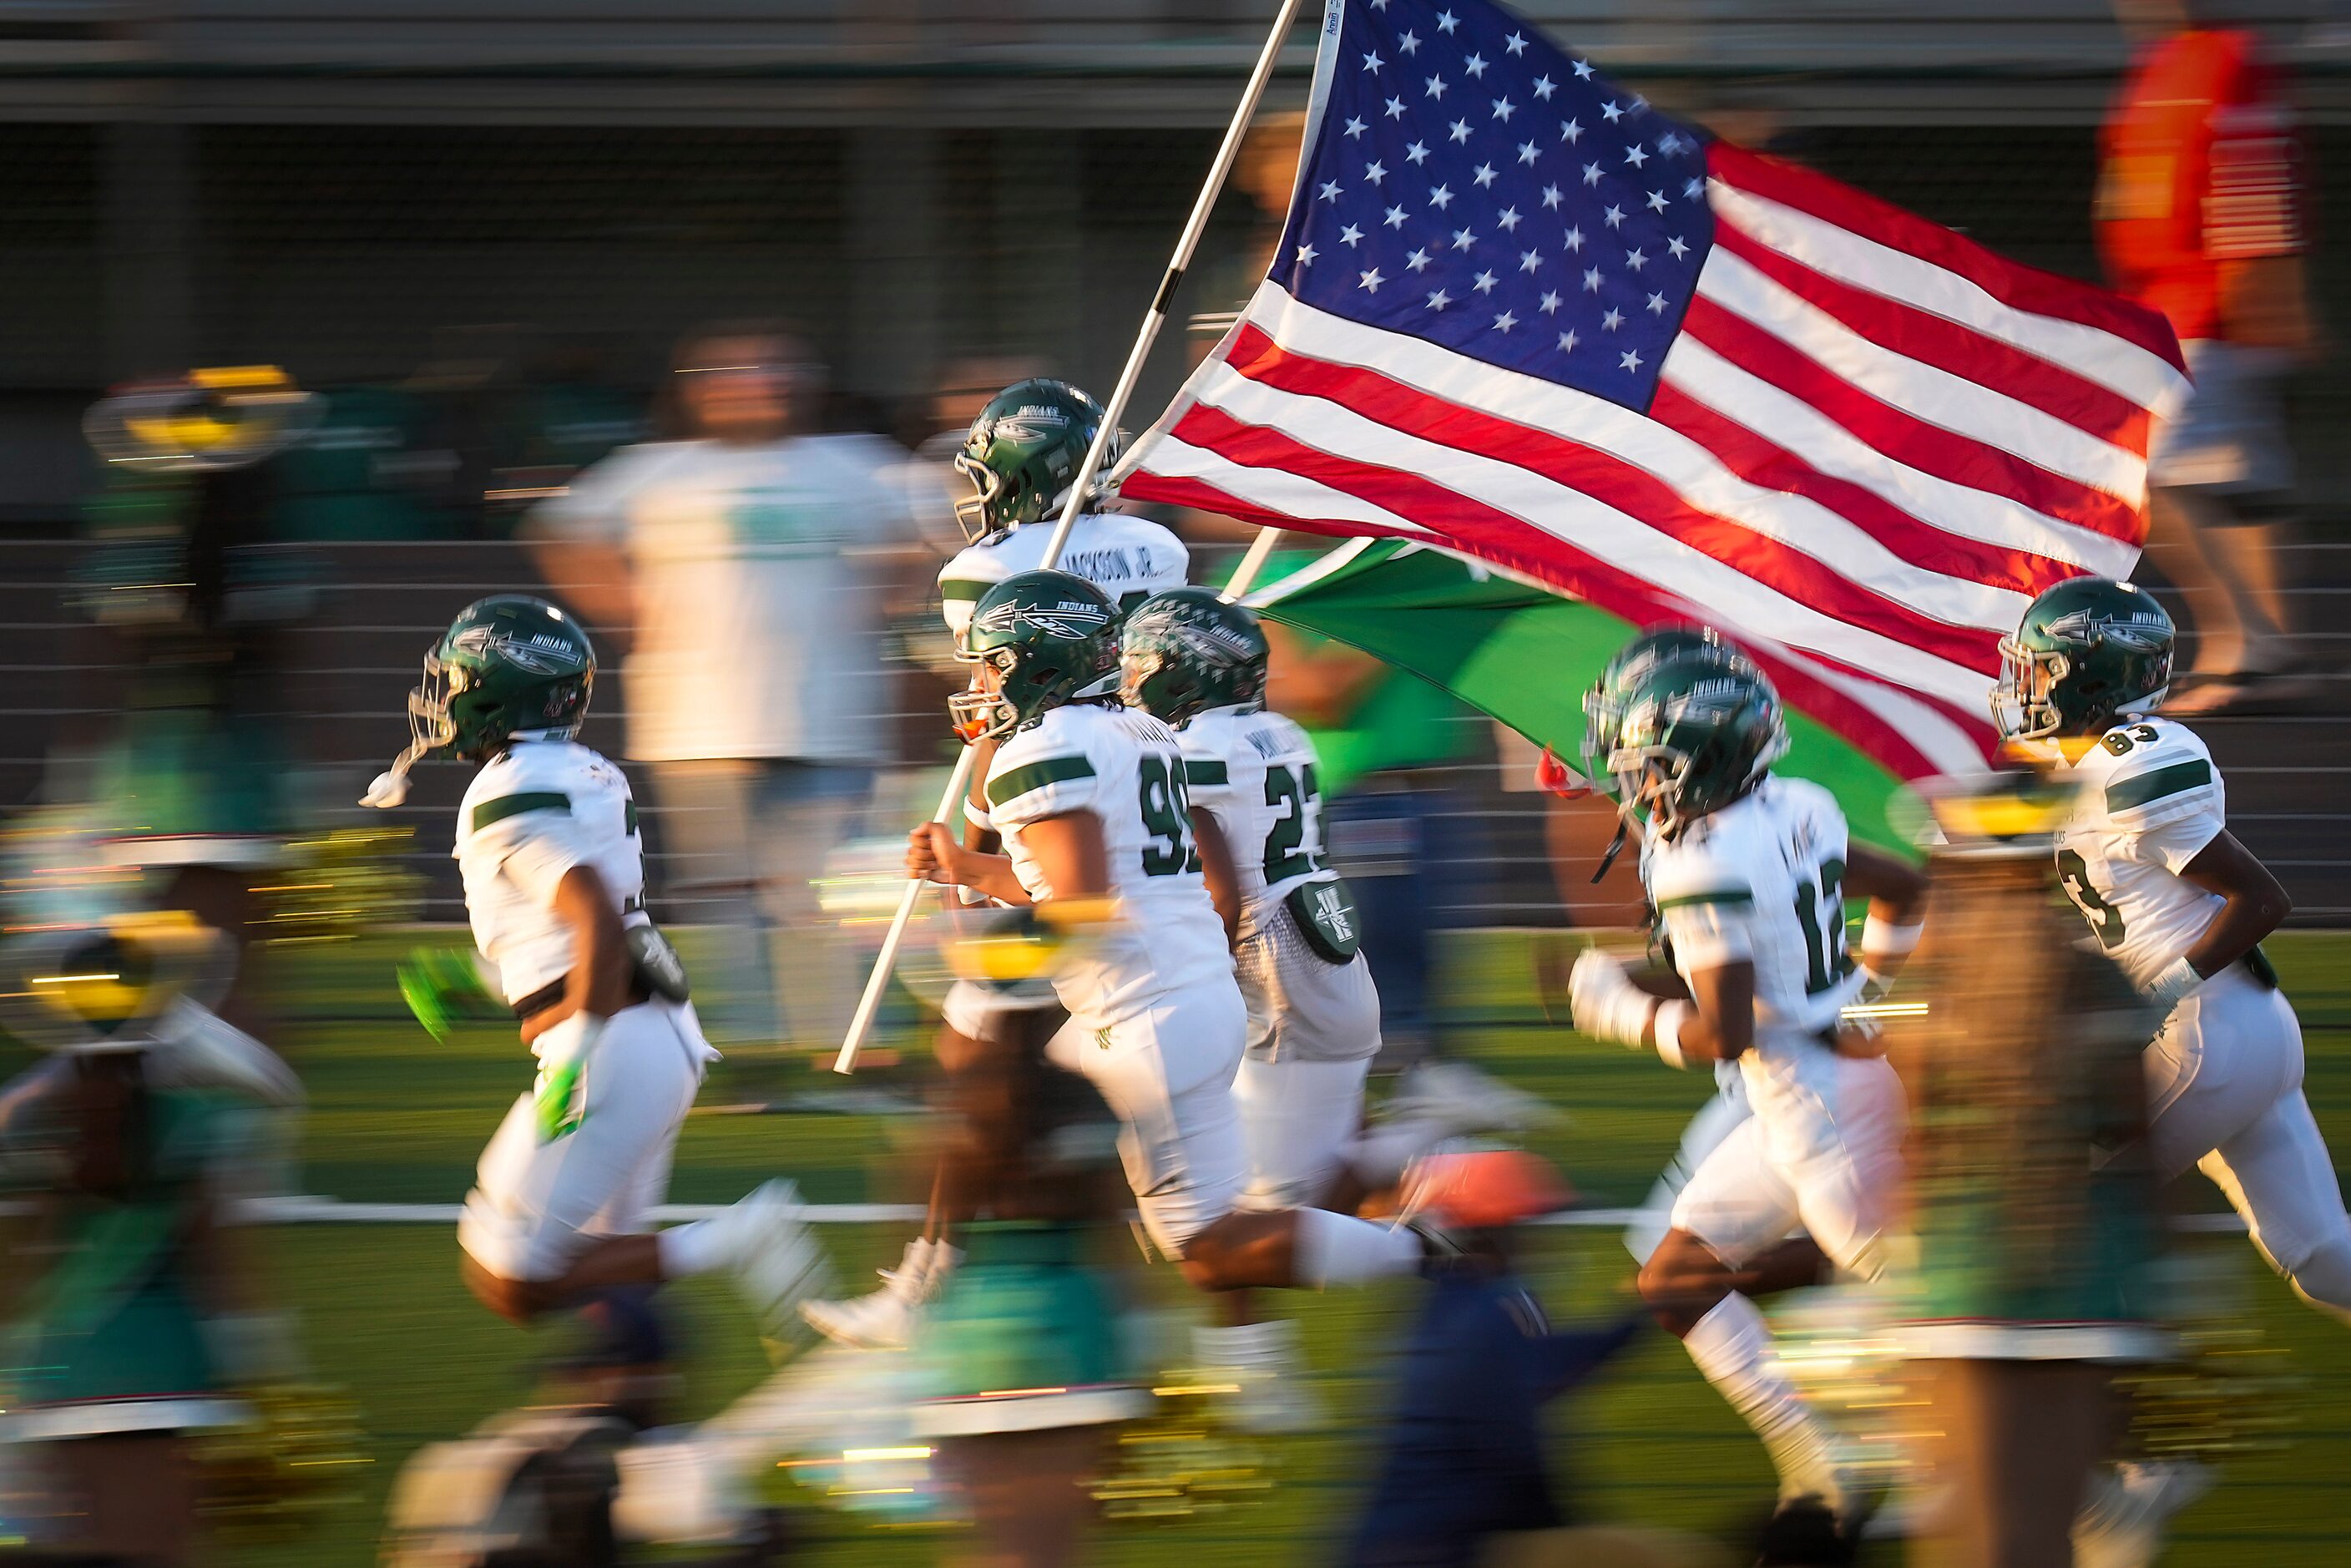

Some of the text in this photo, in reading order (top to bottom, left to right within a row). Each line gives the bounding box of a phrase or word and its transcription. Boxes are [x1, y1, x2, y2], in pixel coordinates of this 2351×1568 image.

[1018, 405, 1059, 417] INDIANS
[1056, 601, 1099, 613] INDIANS
[2132, 611, 2166, 627] INDIANS
[530, 633, 574, 653] INDIANS
[2100, 724, 2160, 756] 83
